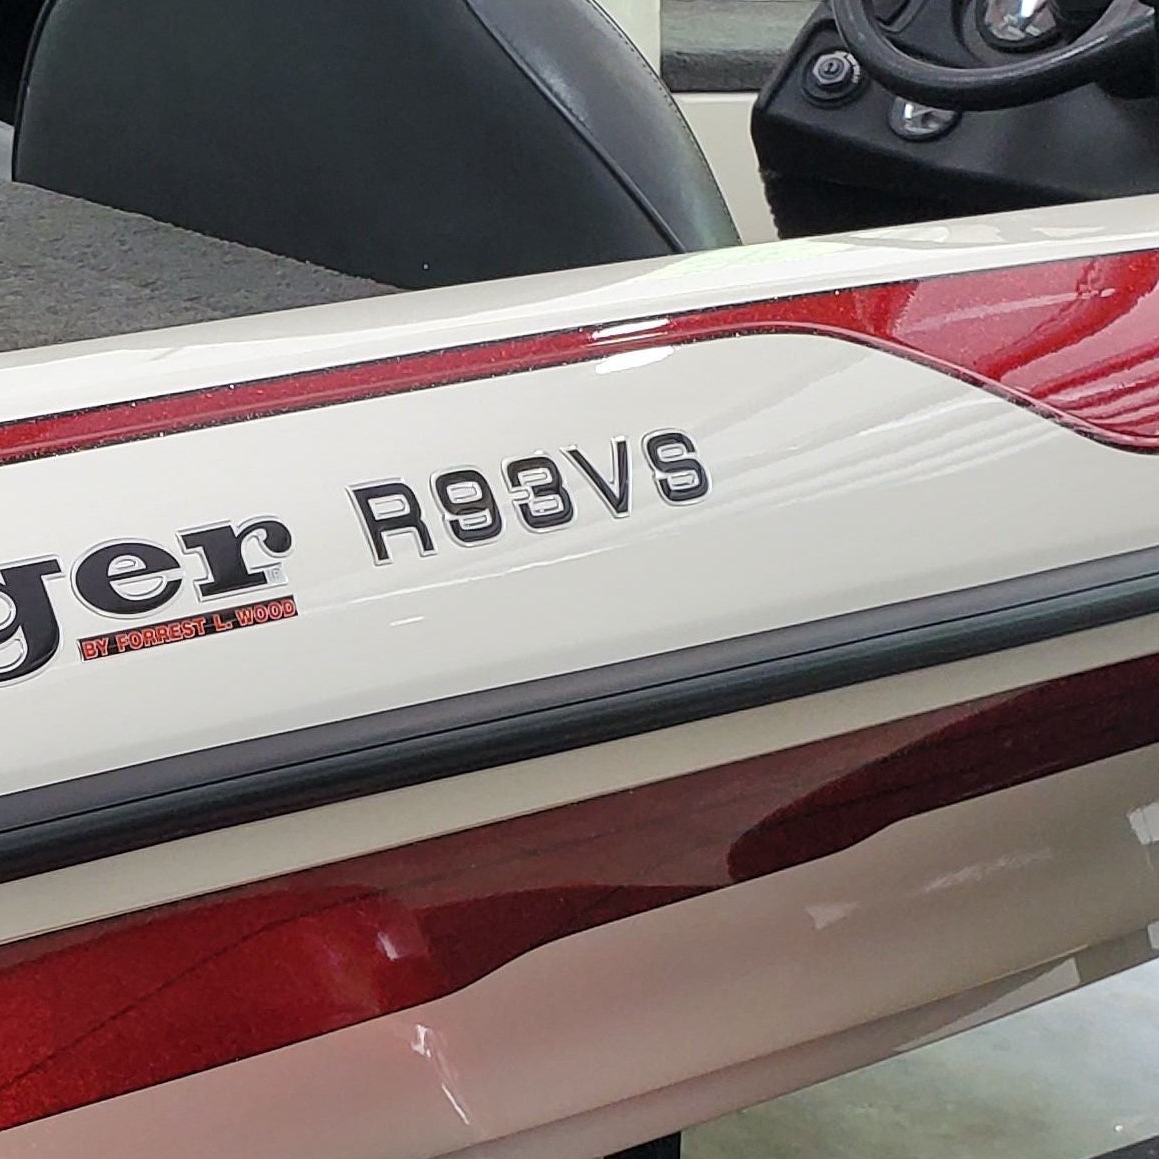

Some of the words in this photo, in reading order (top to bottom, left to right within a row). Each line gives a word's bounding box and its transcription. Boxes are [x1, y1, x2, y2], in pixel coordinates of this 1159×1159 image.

[346, 428, 713, 566] R93VS
[83, 639, 110, 660] BY
[116, 619, 207, 652] FORREST
[213, 613, 232, 631] L.
[236, 599, 296, 626] WOOD
